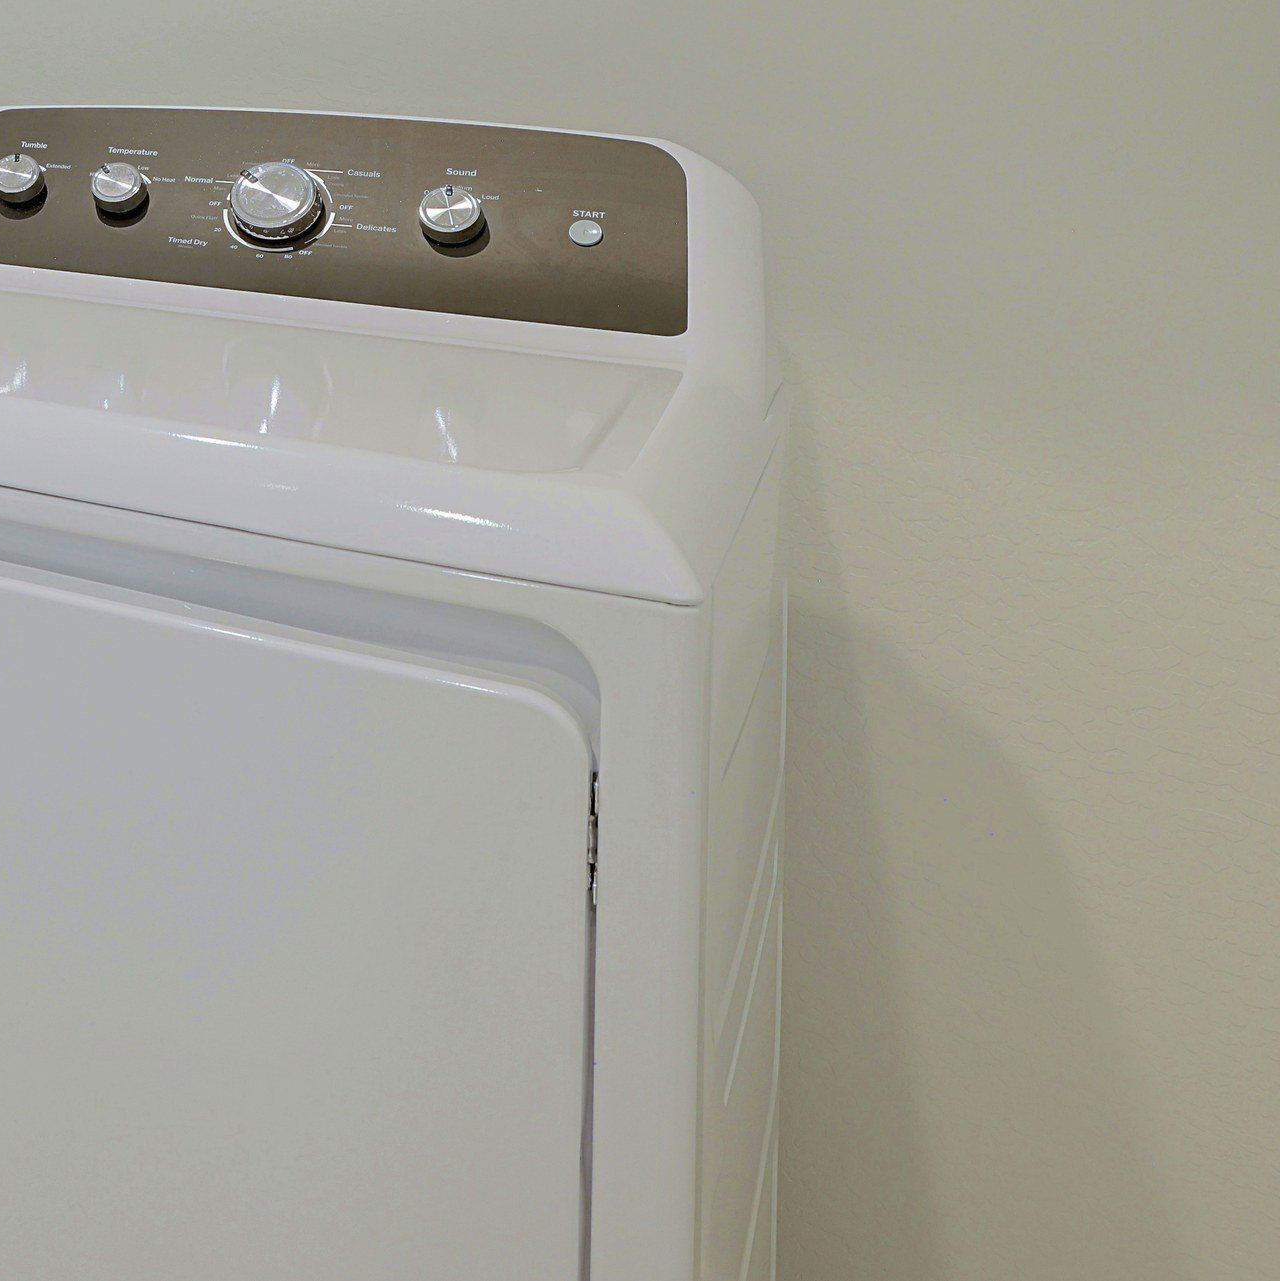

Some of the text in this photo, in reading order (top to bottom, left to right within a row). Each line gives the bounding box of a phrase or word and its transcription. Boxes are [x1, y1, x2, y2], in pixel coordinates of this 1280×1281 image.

[20, 140, 48, 149] Tumble
[108, 146, 158, 157] Temperature
[347, 169, 381, 178] Casuals
[446, 167, 477, 177] Sound
[184, 175, 214, 184] Normal
[572, 209, 606, 219] START
[356, 223, 397, 233] Delicates
[168, 236, 208, 247] Timed Dry
